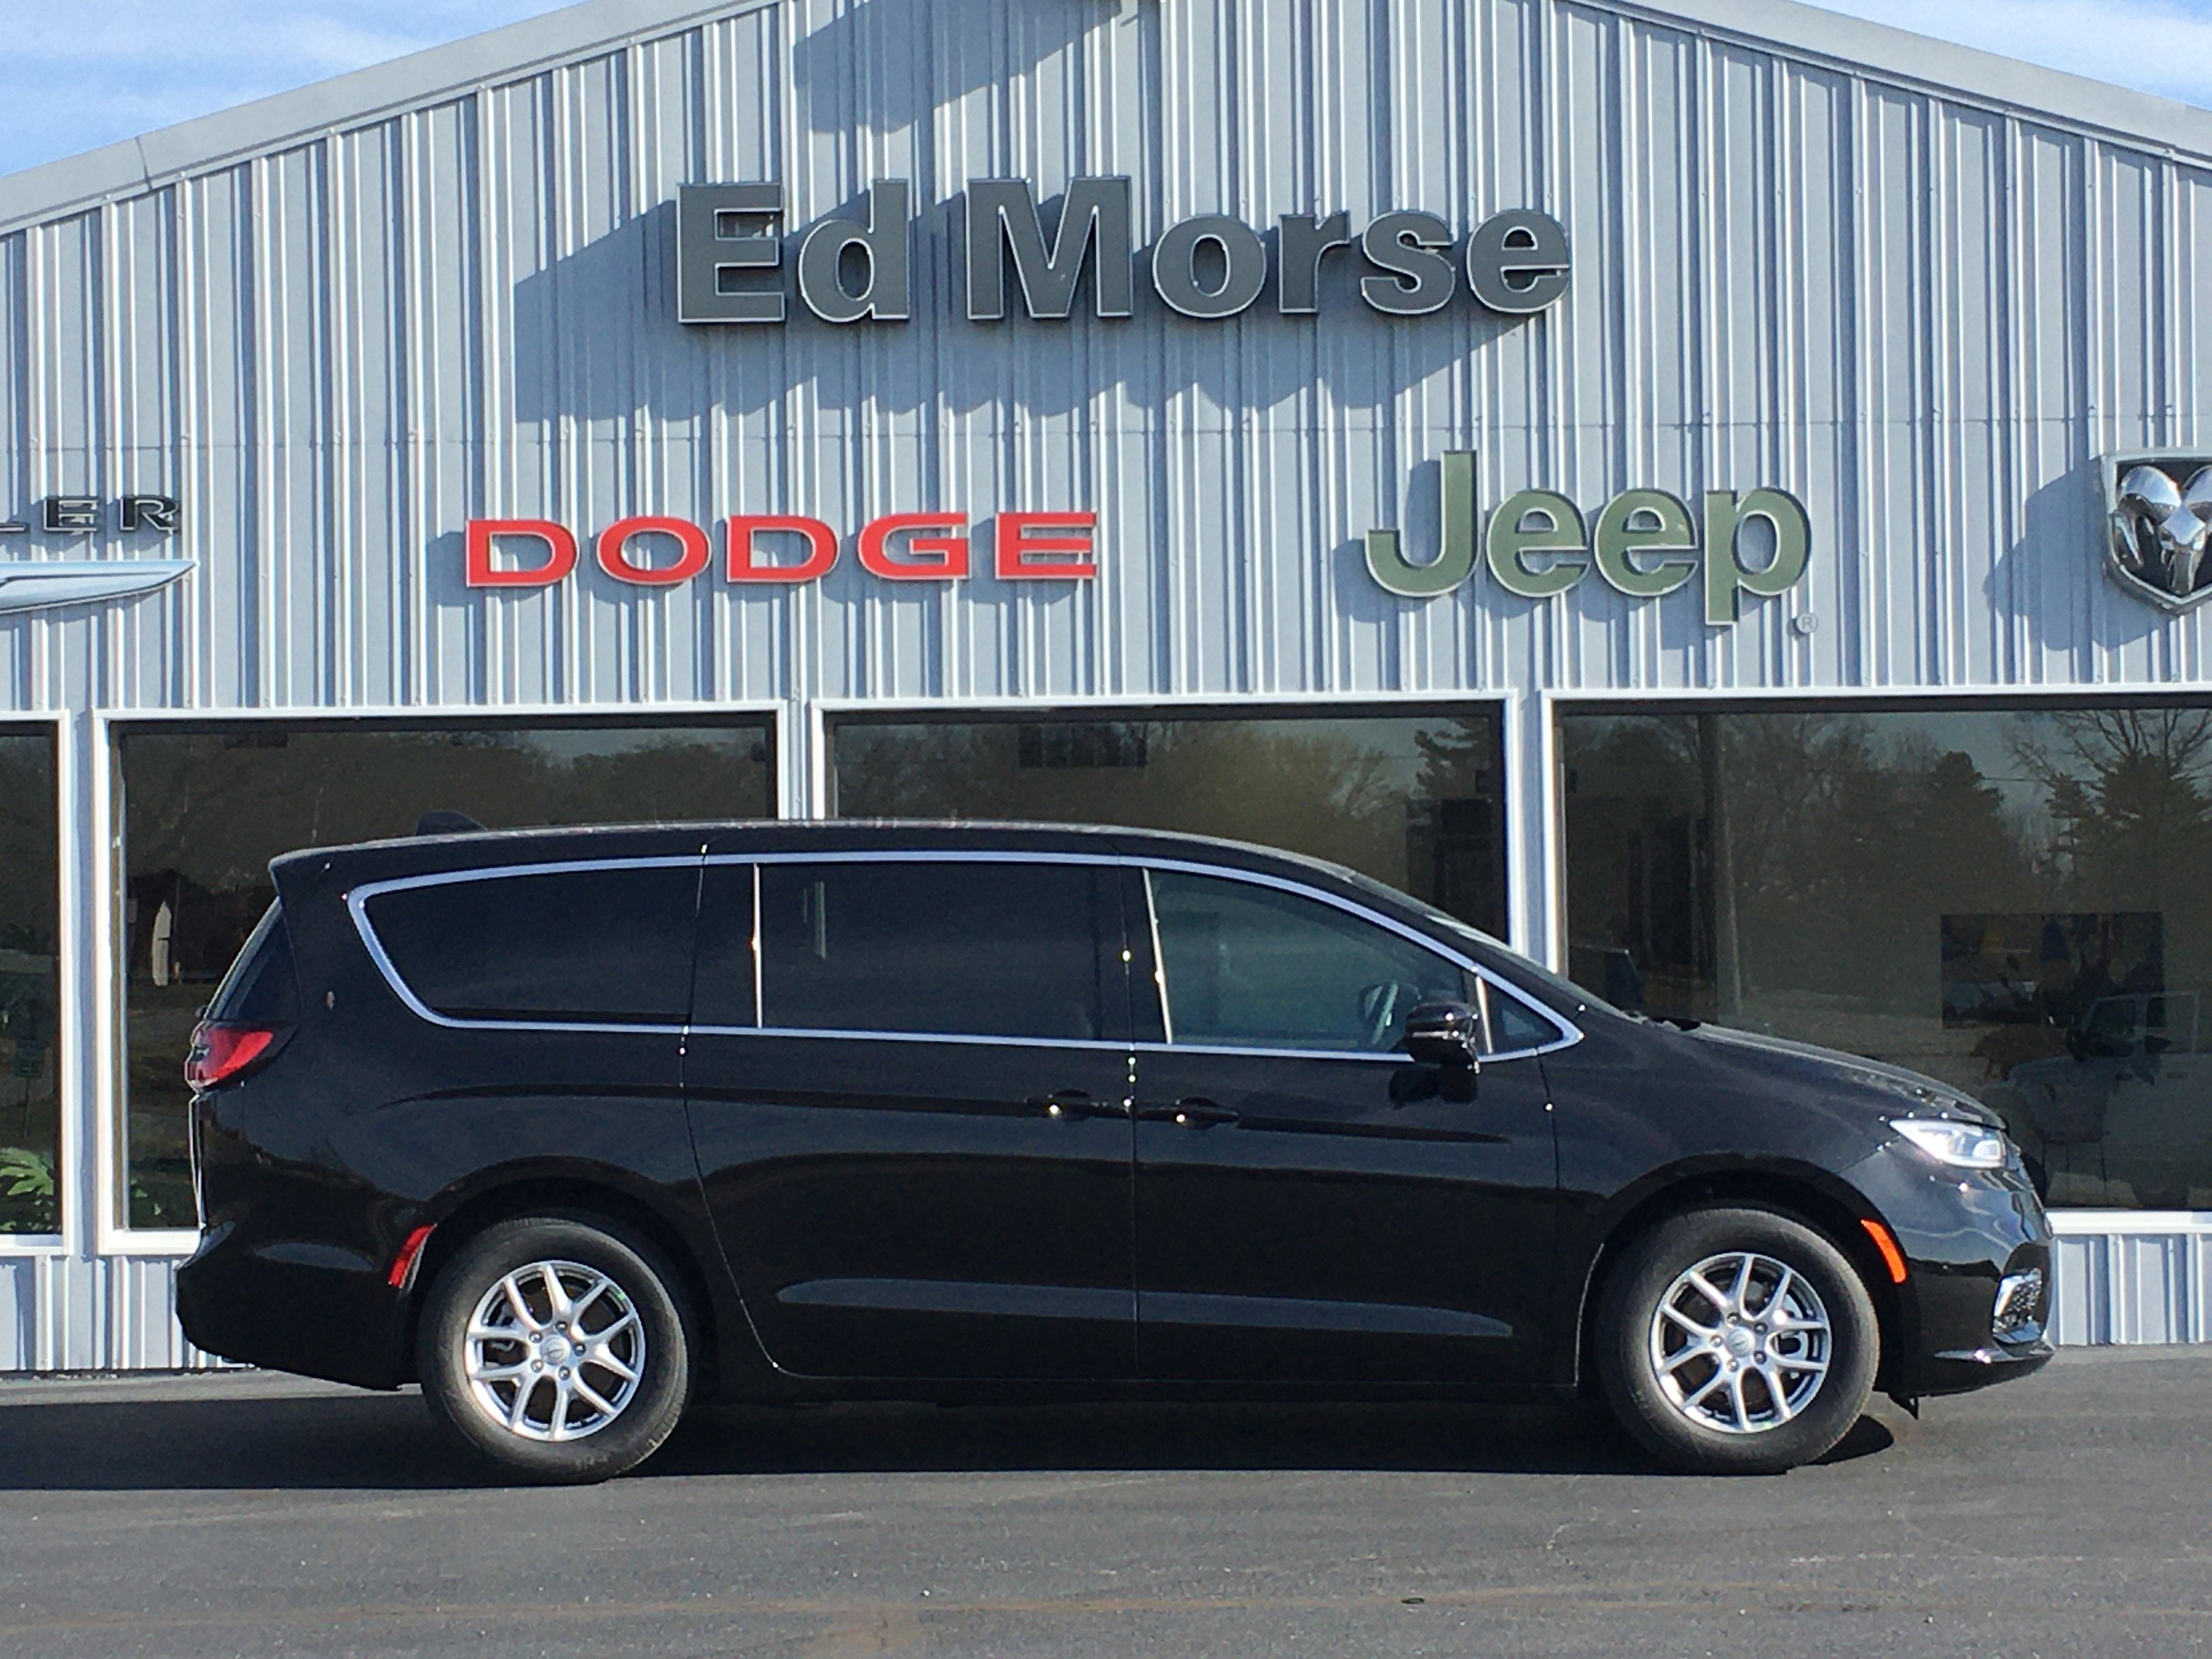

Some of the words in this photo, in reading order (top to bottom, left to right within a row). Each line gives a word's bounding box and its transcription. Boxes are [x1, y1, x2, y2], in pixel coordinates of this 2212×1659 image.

[676, 179, 910, 324] Ed
[966, 176, 1571, 320] Morse
[465, 511, 1097, 587] DODGE
[1364, 449, 1813, 626] Jeep
